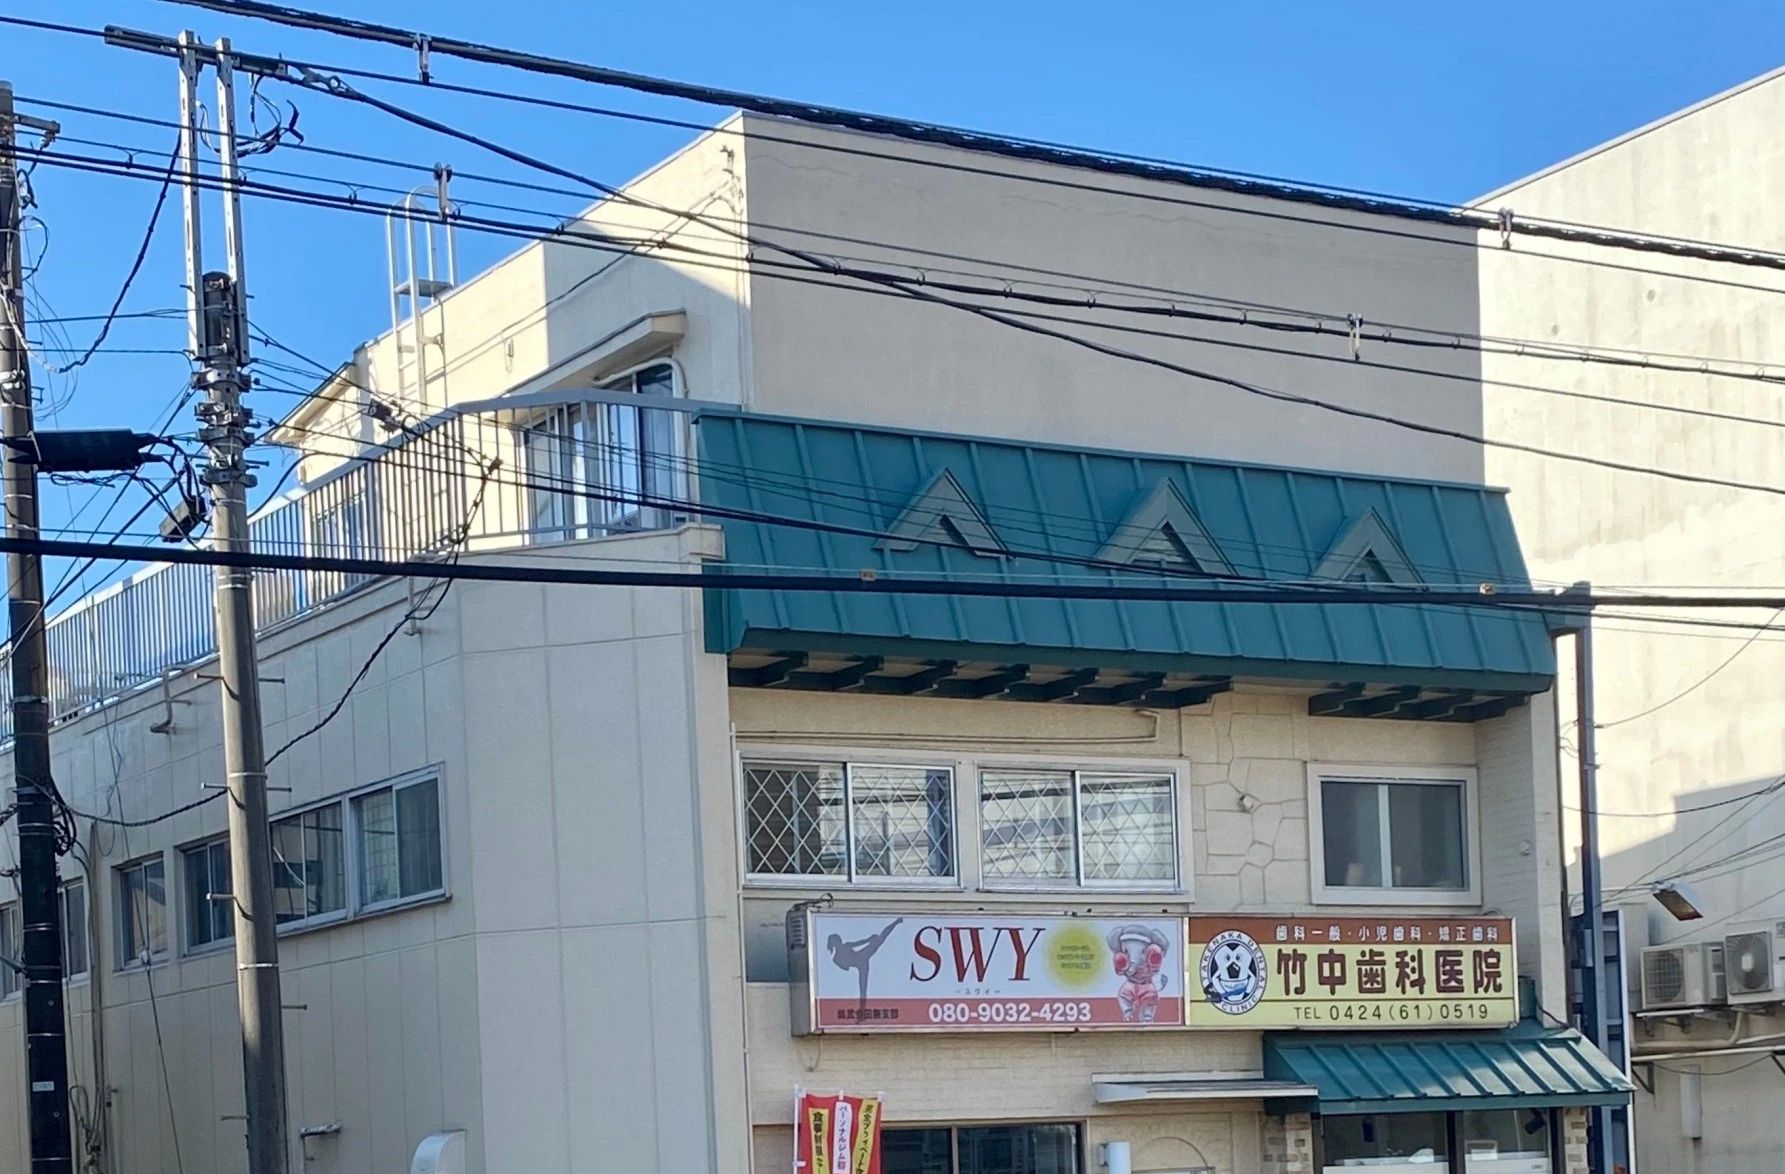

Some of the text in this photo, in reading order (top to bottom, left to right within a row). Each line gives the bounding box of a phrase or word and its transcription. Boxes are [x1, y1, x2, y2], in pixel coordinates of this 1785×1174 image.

[909, 925, 1046, 983] SWY
[1277, 948, 1502, 996] 竹中歯科医院
[928, 1003, 1092, 1023] 080-9032-4293
[1294, 1003, 1489, 1021] TEL 0424(61)0519
